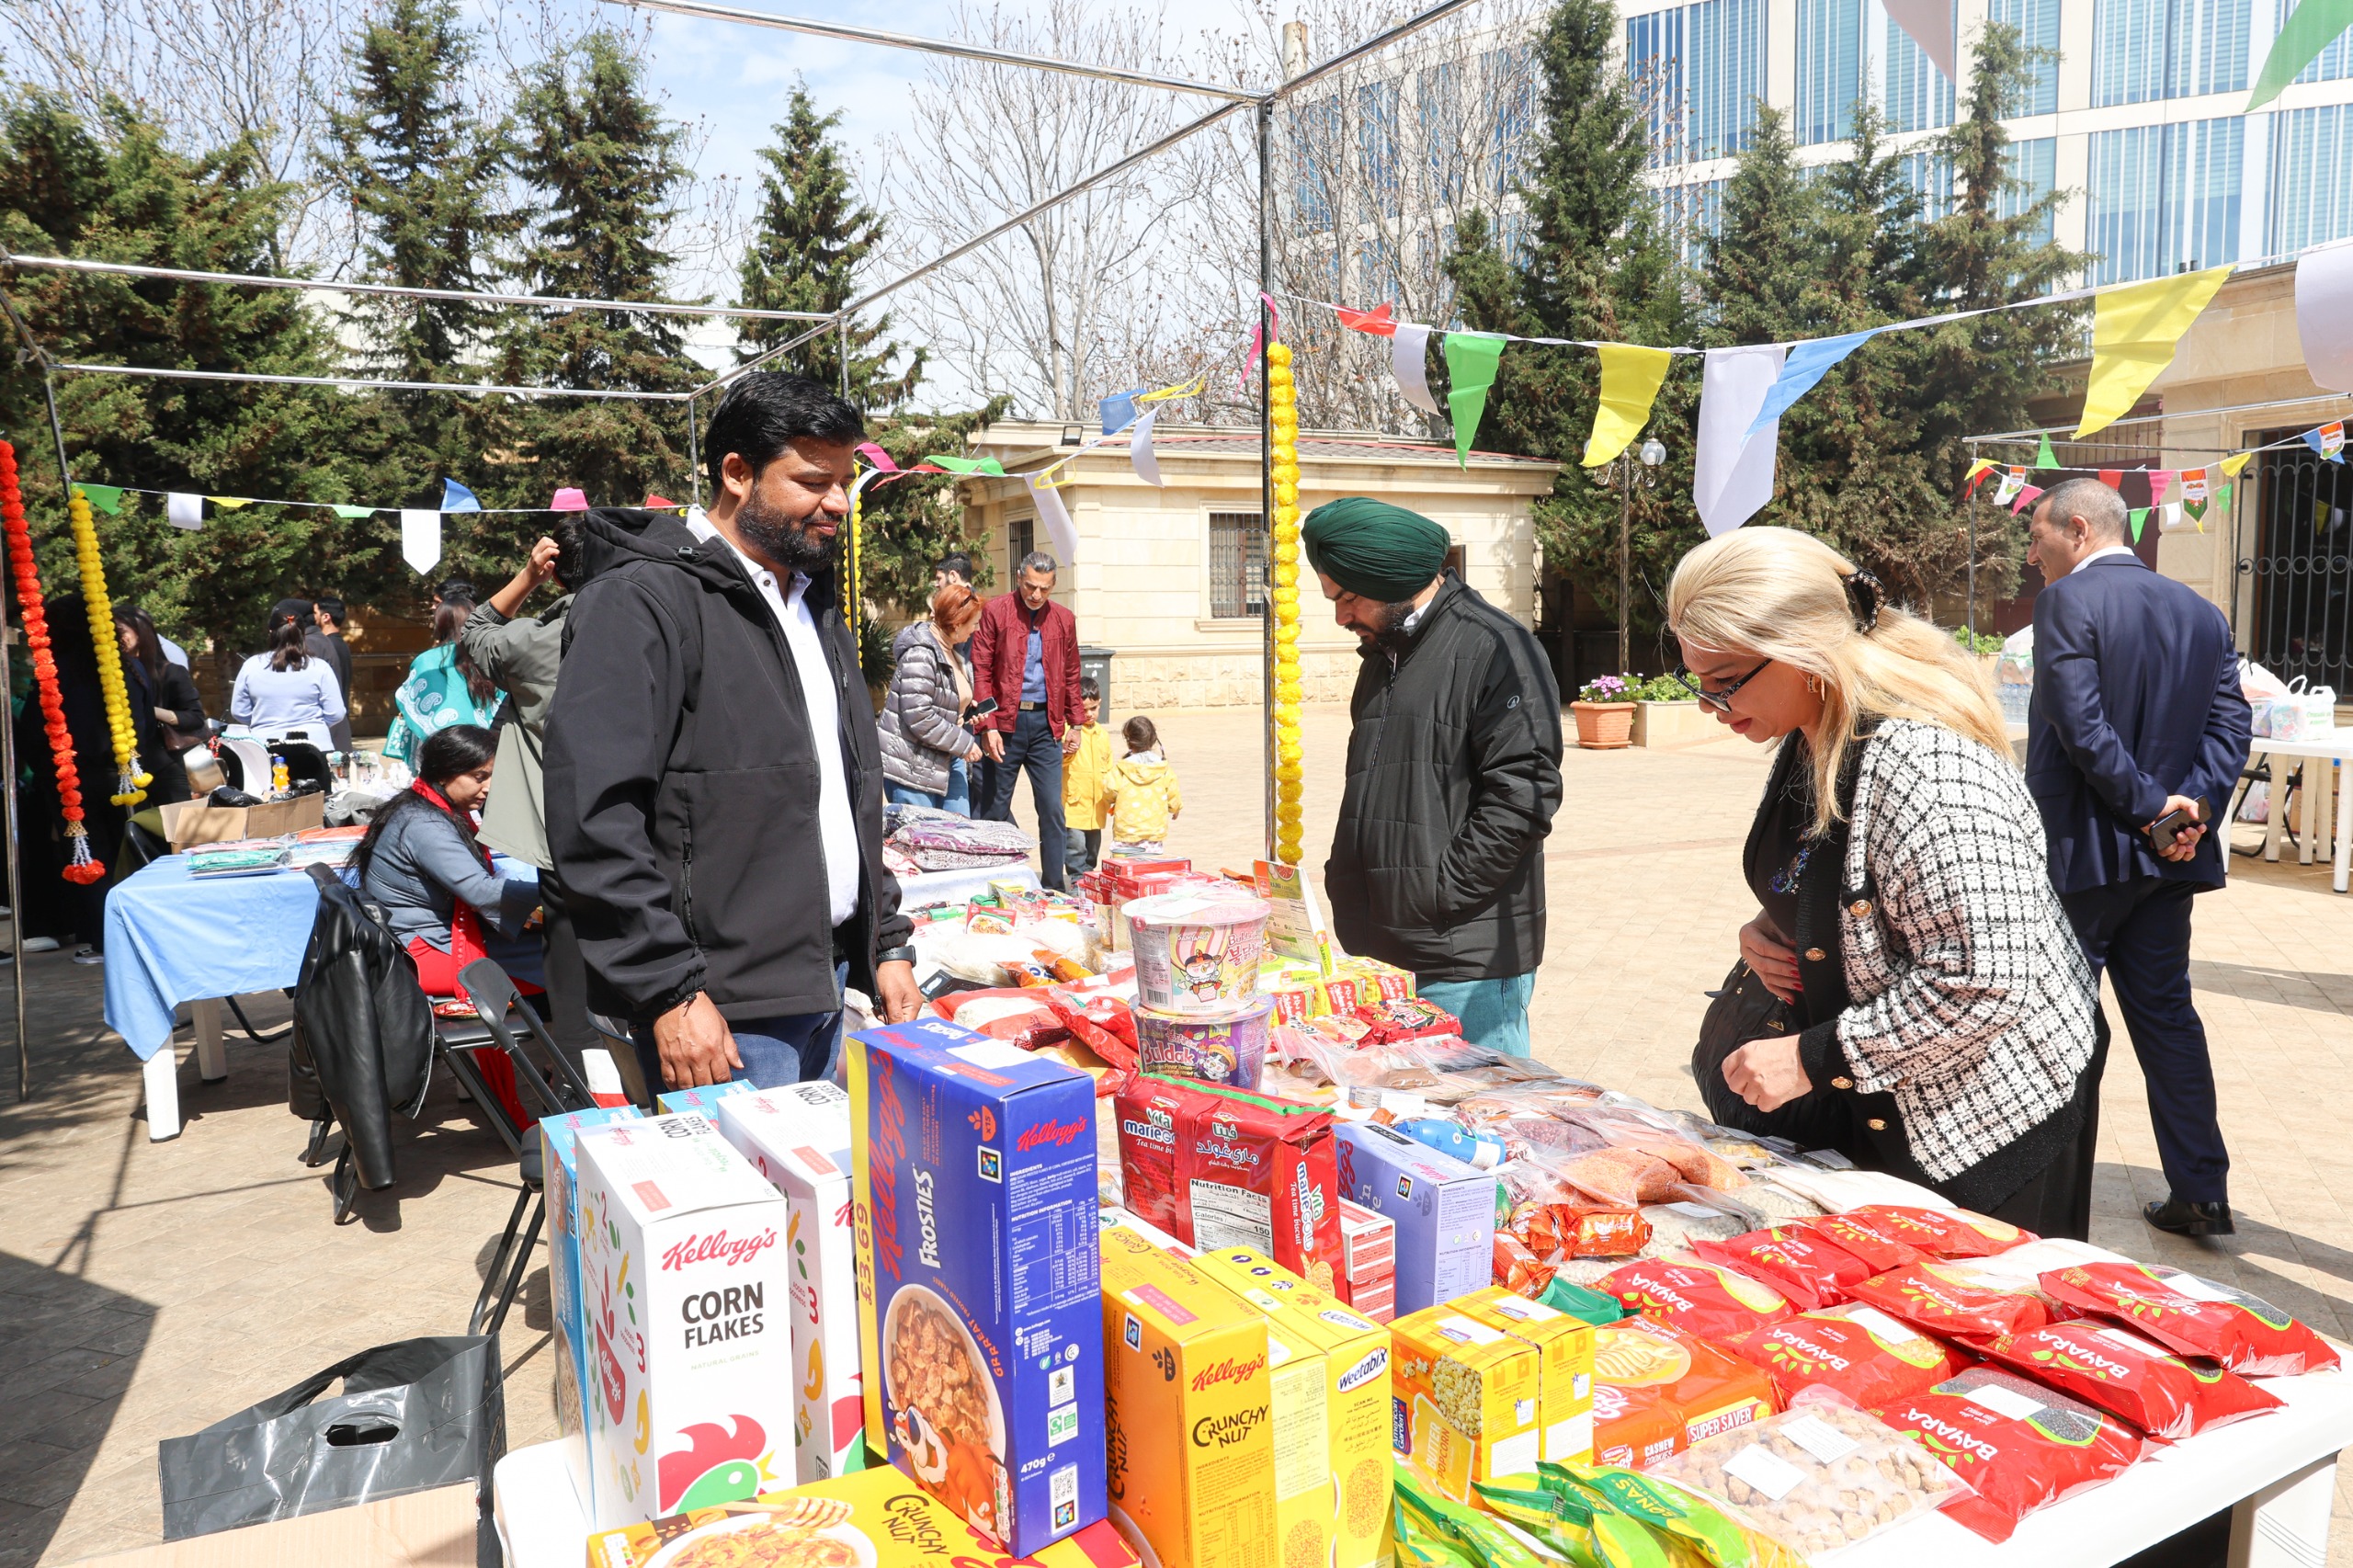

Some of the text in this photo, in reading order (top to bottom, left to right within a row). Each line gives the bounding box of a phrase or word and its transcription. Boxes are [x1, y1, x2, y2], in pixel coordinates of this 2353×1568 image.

[1176, 932, 1208, 941] SAMYANG
[1332, 983, 1347, 1007] Chicken
[1381, 976, 1396, 999] Chicken
[1141, 1040, 1195, 1065] Buldak
[792, 1086, 831, 1105] CORN
[655, 1119, 692, 1139] CORN
[682, 1116, 714, 1135] FLAKES
[1017, 1116, 1087, 1152] Kellogg's
[1146, 1108, 1172, 1130] Vita
[1136, 1139, 1148, 1147] Tea
[1150, 1142, 1164, 1152] time
[869, 1050, 905, 1282] Kellogg's
[1009, 1164, 1042, 1177] INGREDIENTS
[1191, 1179, 1267, 1203] Nutrition Facts
[1296, 1161, 1314, 1252] marieGOLD
[1310, 1183, 1324, 1221] Vita
[913, 1165, 941, 1269] FROSTIES
[1011, 1199, 1073, 1222] NUTRITION INFORMATION
[1195, 1211, 1223, 1222] Calories
[1254, 1225, 1270, 1236] 150
[1293, 1219, 1302, 1244] biscuit
[662, 1227, 778, 1270] Kellogg's
[856, 1202, 873, 1306] £3.69
[1457, 1244, 1482, 1254] INFORMATION
[682, 1281, 764, 1324] CORN
[808, 1286, 818, 1324] 3
[1631, 1273, 1695, 1312] BAYARA
[685, 1312, 764, 1349] FLAKES
[968, 1319, 1004, 1377] GRREAT
[636, 1333, 645, 1373] 3
[690, 1350, 759, 1370] NATURAL GRAINS
[1772, 1328, 1849, 1372] BAYARA
[1995, 1342, 2010, 1355] FROM
[2039, 1330, 2131, 1379] BAYARA
[599, 1349, 621, 1403] Kellogg's
[1191, 1353, 1265, 1392] Kellogg's
[1338, 1348, 1388, 1390] Weetabix
[1192, 1404, 1269, 1448] CRUNCHY
[1690, 1407, 1752, 1442] SUPER SAVER
[1964, 1405, 1997, 1424] URID WHOLE
[1106, 1385, 1126, 1500] CRUNCHY
[1117, 1423, 1129, 1473] NUT
[1218, 1426, 1252, 1449] NUT
[1426, 1422, 1442, 1469] BUTTER
[1644, 1437, 1675, 1458] CASHEW
[1907, 1407, 1998, 1461] BAYARA
[1020, 1458, 1046, 1474] 470g
[1196, 1455, 1230, 1471] INGREDIENTS
[1438, 1428, 1449, 1479] POPCORN
[1644, 1449, 1674, 1466] COOKIES
[1198, 1491, 1261, 1517] NUTRITION INFORMATION
[1618, 1479, 1677, 1517] SONAS
[882, 1517, 917, 1545] NUT
[883, 1494, 949, 1555] CRUNCHY
